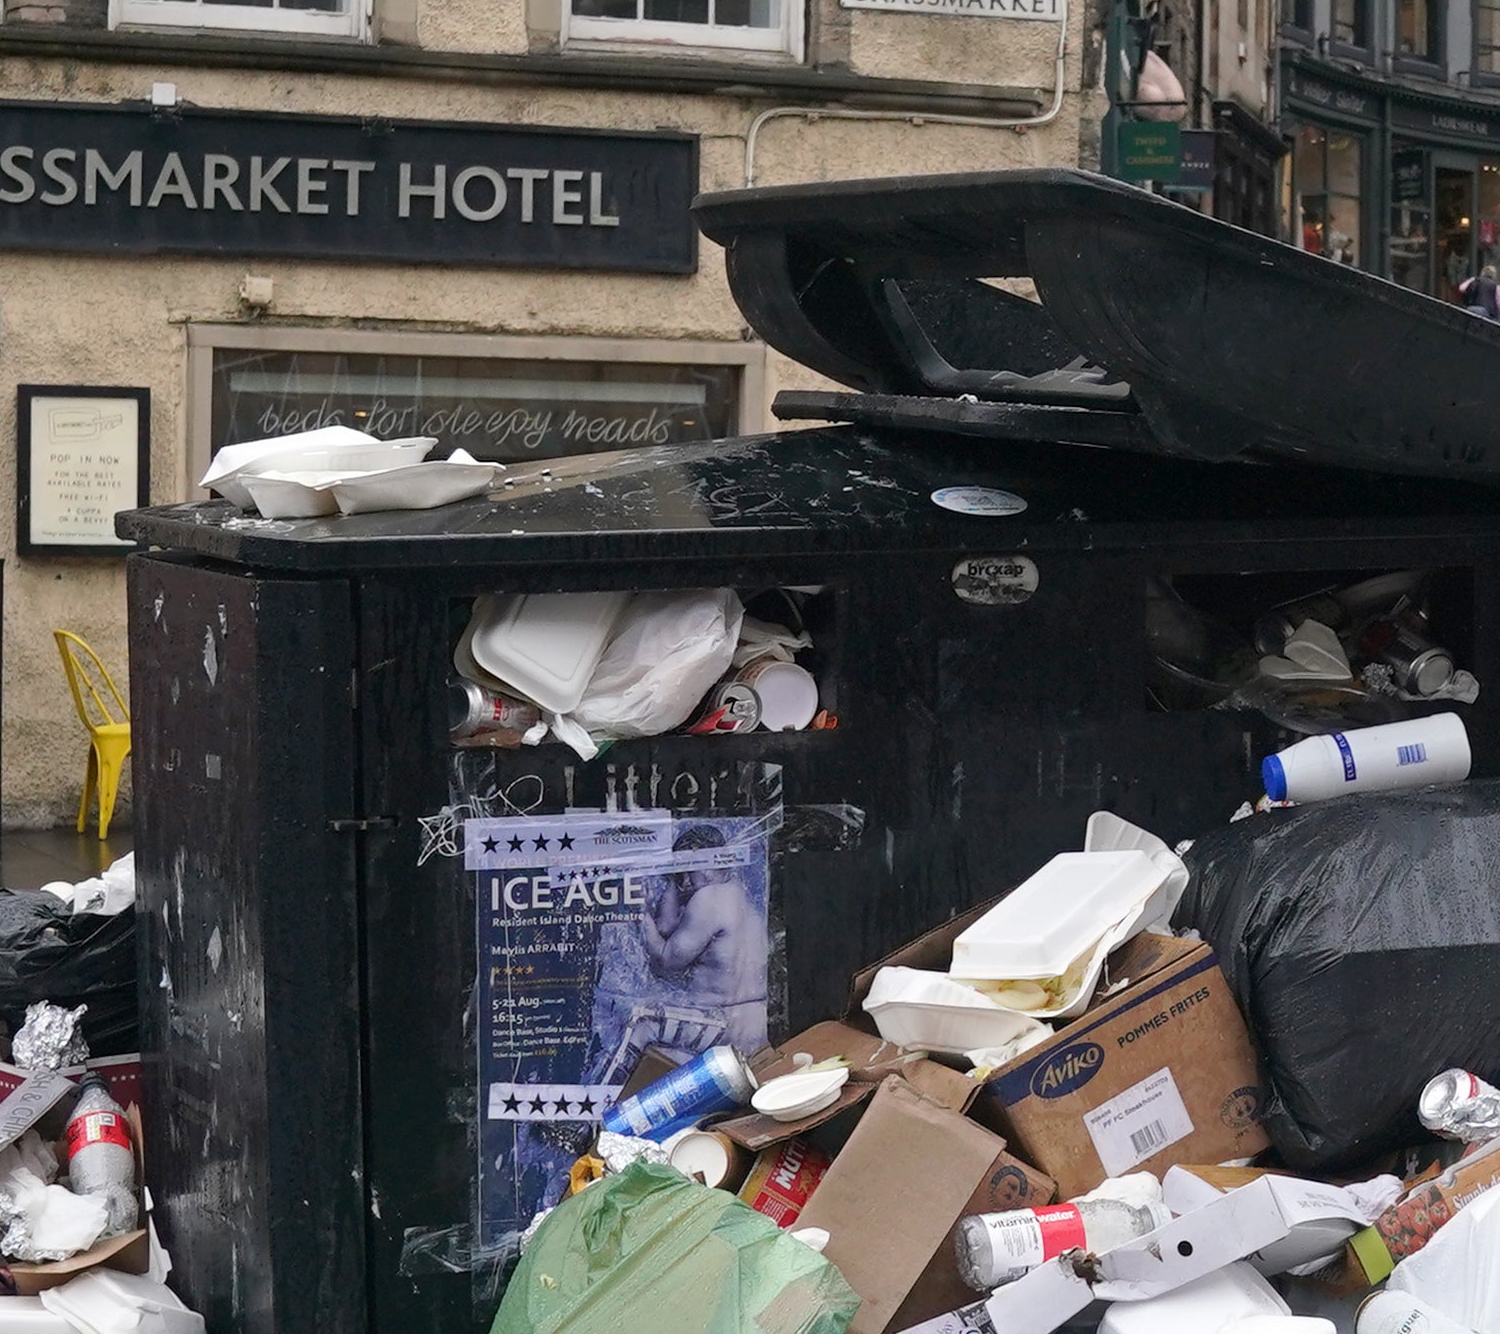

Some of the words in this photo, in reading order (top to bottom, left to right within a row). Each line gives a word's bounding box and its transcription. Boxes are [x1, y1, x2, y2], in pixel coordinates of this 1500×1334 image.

[397, 161, 621, 227] HOTEL
[49, 453, 71, 464] POP
[79, 454, 93, 464] IN
[610, 833, 658, 845] SCOTSMAN
[491, 875, 553, 912] ICE
[564, 872, 646, 907] AGE
[492, 917, 537, 928] Resident
[539, 915, 573, 925] Island
[604, 911, 645, 922] Theatre
[1116, 1012, 1169, 1050] POMMES
[1169, 985, 1211, 1020] FRITES
[19, 1089, 43, 1105] &
[988, 1209, 1077, 1230] vitaminwater
